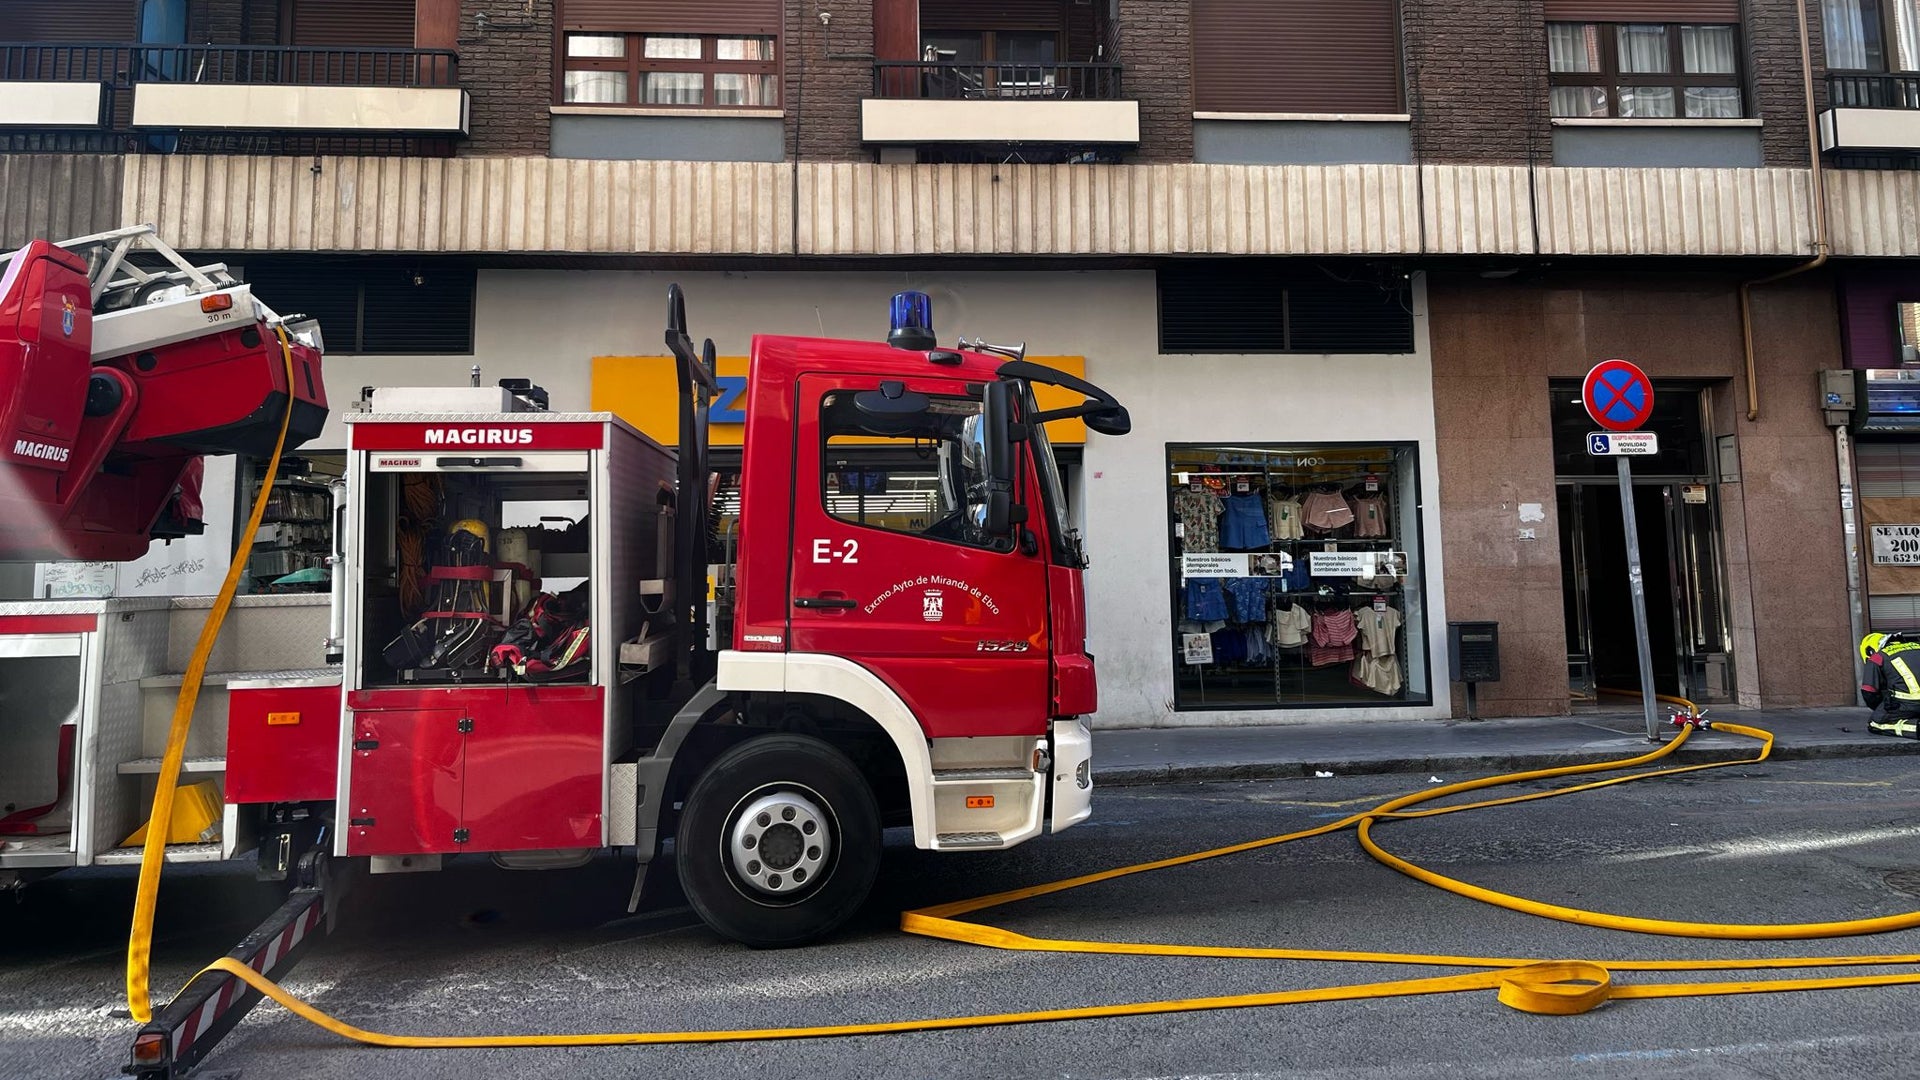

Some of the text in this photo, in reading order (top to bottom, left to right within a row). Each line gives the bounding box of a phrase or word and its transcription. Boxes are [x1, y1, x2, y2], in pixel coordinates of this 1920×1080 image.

[207, 312, 231, 323] 30 m
[425, 429, 533, 444] MAGIRUS
[13, 439, 70, 462] MAGIRUS
[1876, 527, 1892, 536] SE
[813, 539, 858, 564] E-2
[1890, 540, 1919, 552] 200
[1893, 554, 1911, 563] 652
[930, 575, 968, 591] Miranda
[970, 587, 982, 599] de
[982, 595, 1000, 615] Ebro
